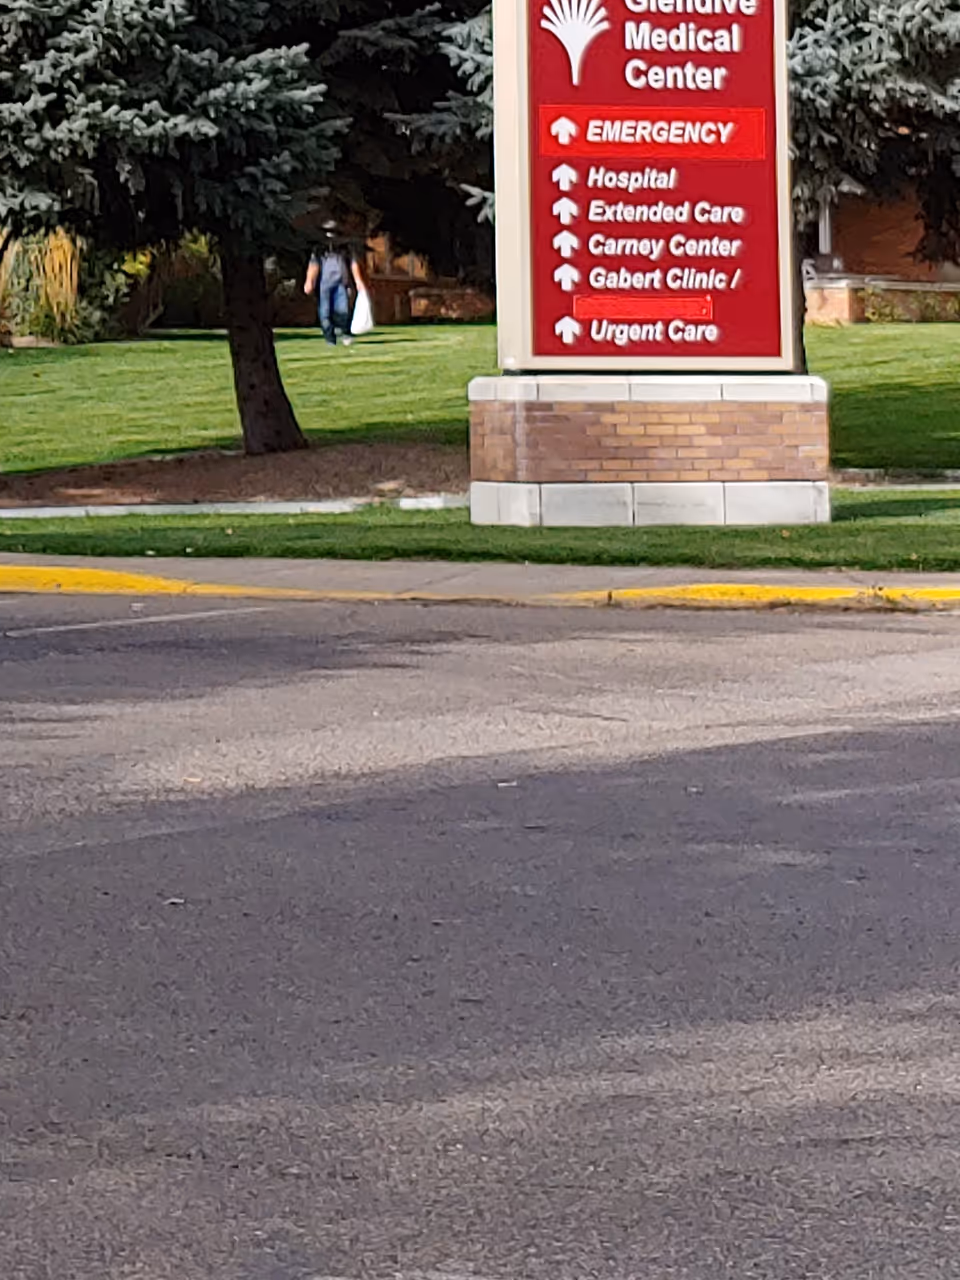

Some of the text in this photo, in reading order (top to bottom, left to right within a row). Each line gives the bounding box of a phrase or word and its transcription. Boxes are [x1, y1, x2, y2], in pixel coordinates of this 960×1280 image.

[624, 21, 742, 52] Medical
[624, 58, 727, 90] Center
[586, 120, 735, 144] EMERGENCY
[587, 166, 677, 193] Hospital
[588, 200, 745, 224] Extended Care
[588, 233, 742, 261] Carney Center
[589, 266, 661, 289] Gabert
[666, 267, 728, 290] Clinic
[590, 319, 720, 346] Urgent Care
